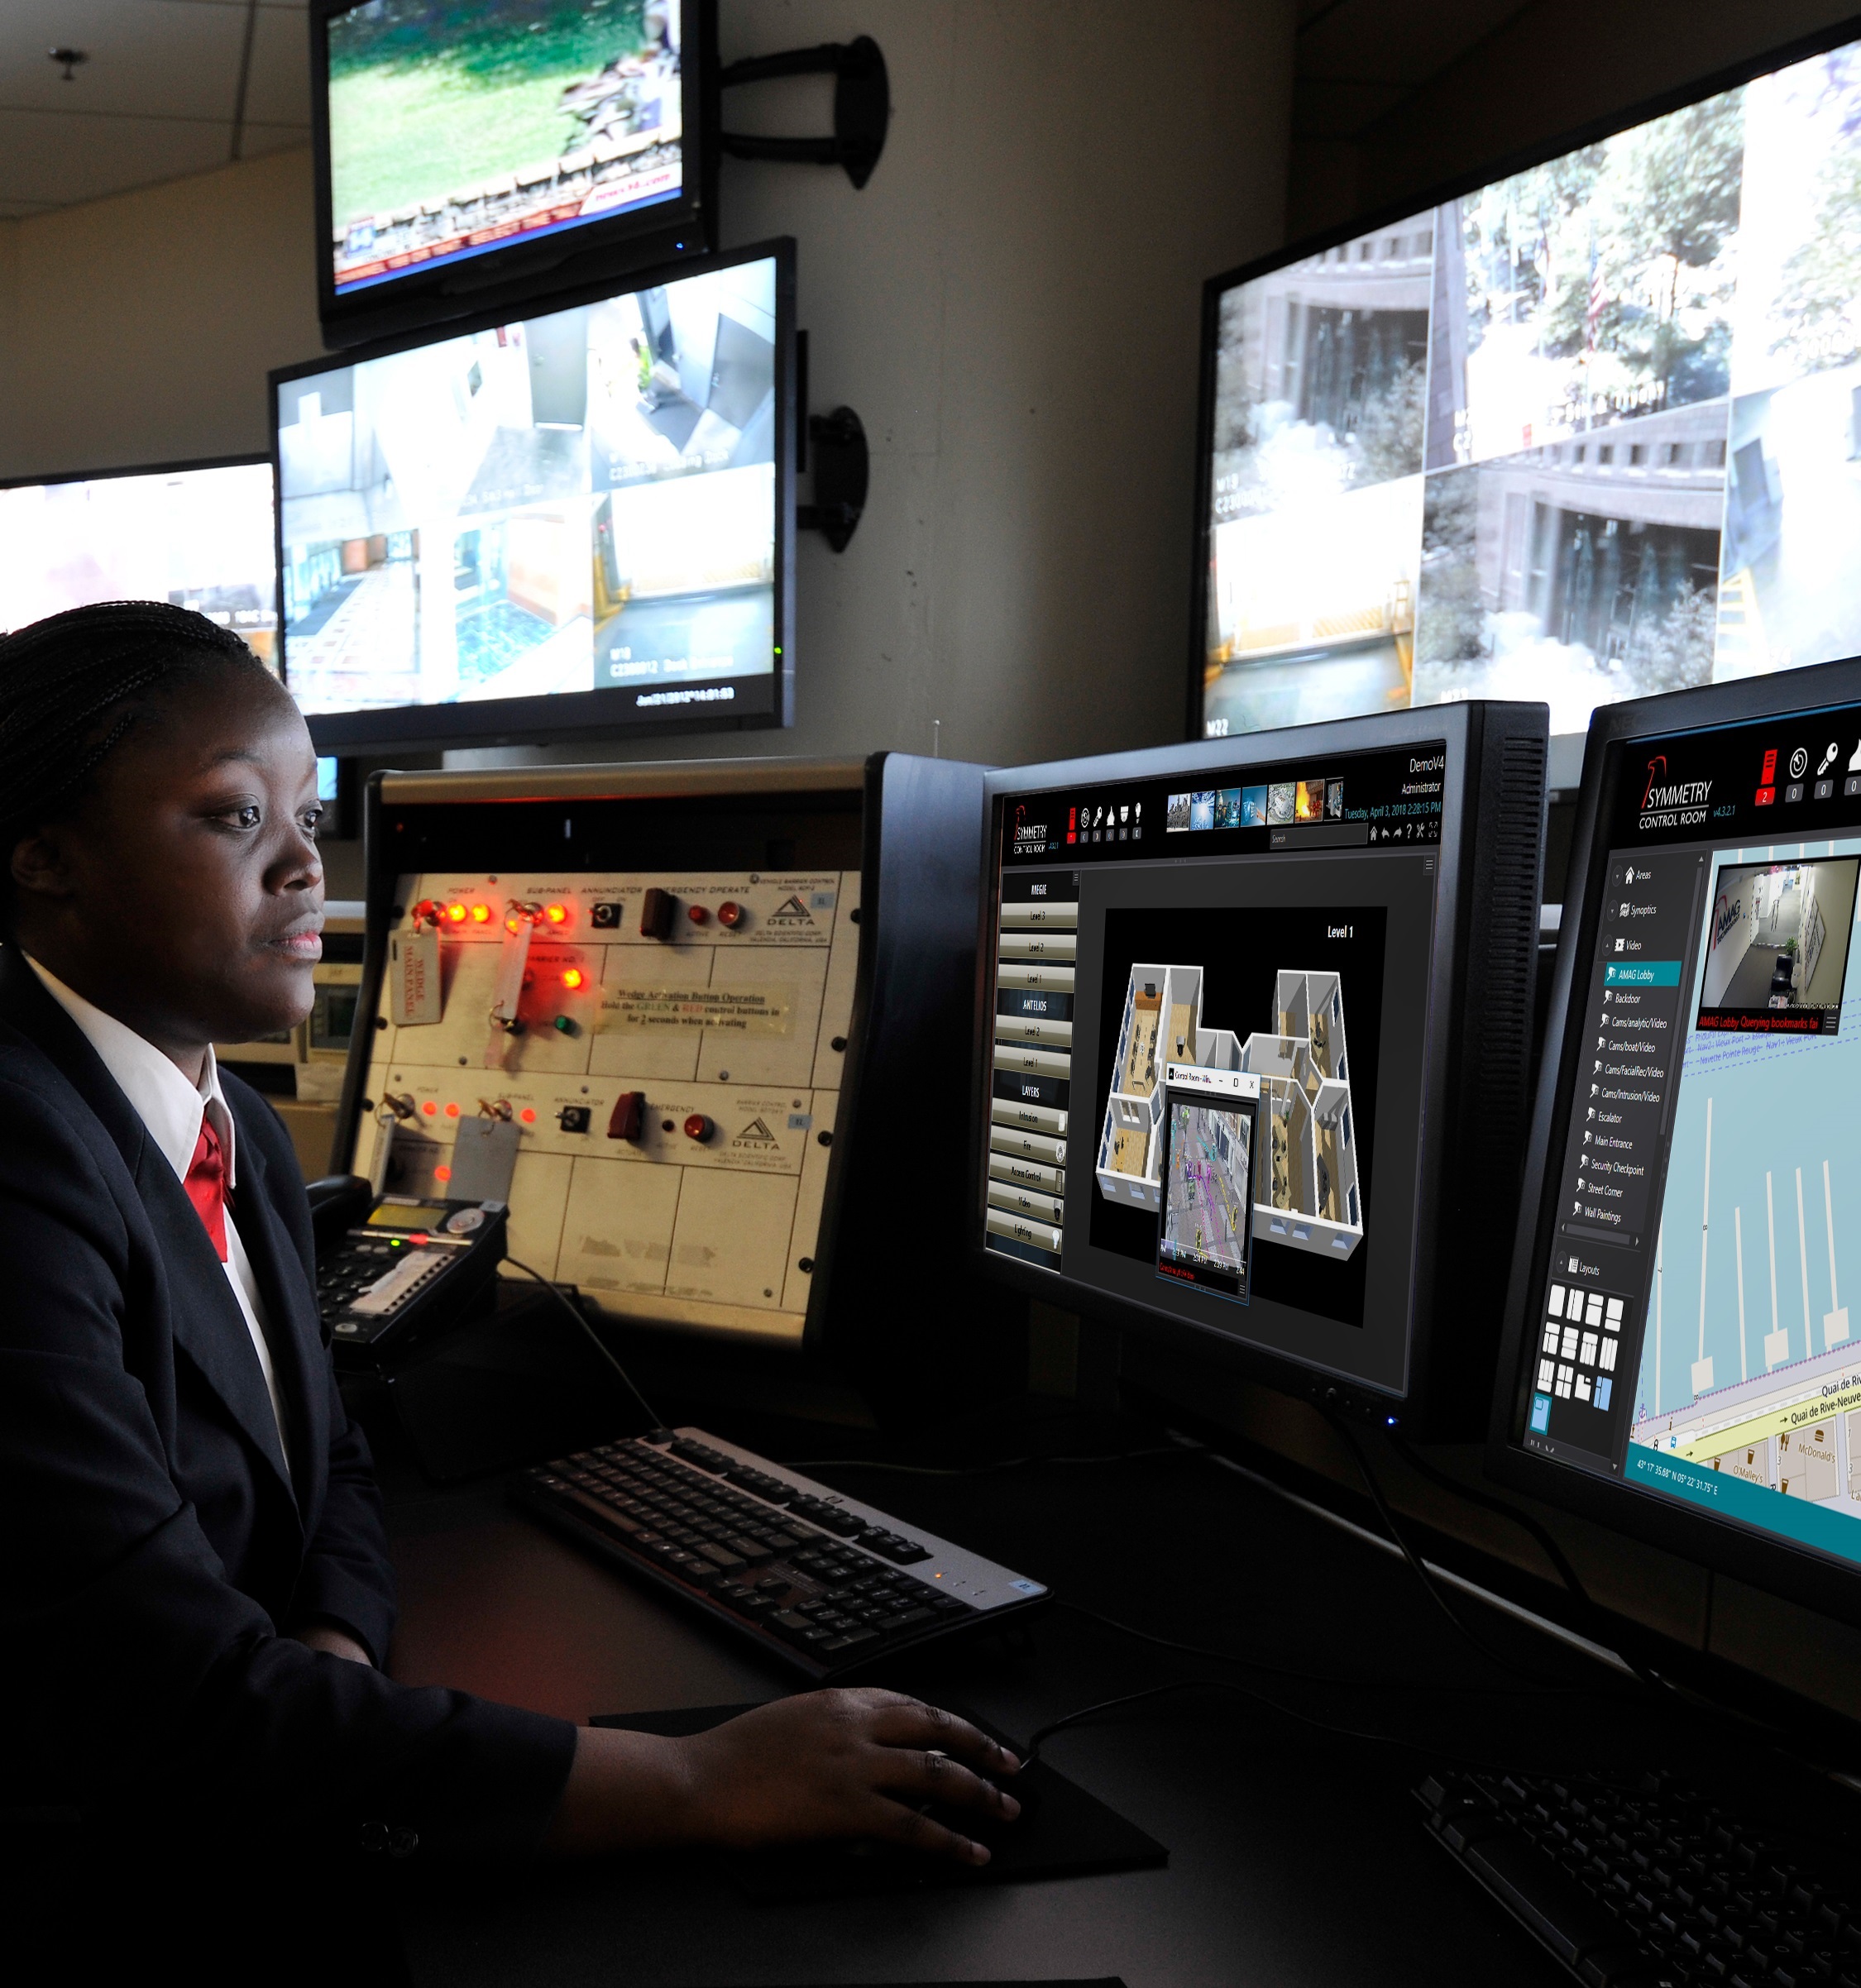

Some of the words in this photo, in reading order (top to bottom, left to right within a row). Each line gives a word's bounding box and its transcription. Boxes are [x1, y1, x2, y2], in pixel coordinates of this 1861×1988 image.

[1409, 755, 1445, 773] DemoV4
[1401, 782, 1442, 795] Administrator
[1820, 784, 1826, 796] 0
[1851, 780, 1857, 792] 0
[1647, 780, 1713, 809] SYMMETRY
[1762, 791, 1768, 803] 2
[1792, 787, 1797, 800] 0
[1370, 805, 1385, 820] April
[1391, 803, 1407, 816] 2018
[1430, 800, 1442, 813] PM
[1639, 813, 1678, 829] CONTROL
[1680, 810, 1707, 825] ROOM
[1635, 870, 1652, 880] Areas
[1630, 905, 1657, 916] Synoptics
[766, 918, 816, 926] DELTA
[1328, 925, 1347, 938] Level
[1349, 925, 1353, 938] 1
[1626, 939, 1642, 951] Video
[1619, 969, 1637, 980] AMAG
[1637, 969, 1655, 982] Lobby
[1615, 992, 1641, 1004] Backdoor
[672, 1003, 680, 1012] &
[737, 1006, 769, 1016] buttons
[771, 1007, 780, 1016] in
[627, 1013, 639, 1023] for
[648, 1015, 680, 1025] seconds
[682, 1016, 703, 1026] when
[1611, 1016, 1667, 1030] Cams/analytic/Video
[1698, 1016, 1720, 1028] AMAG
[1720, 1016, 1739, 1030] Lobby
[1740, 1016, 1770, 1031] Querying
[1771, 1016, 1808, 1030] bookmarks
[1608, 1039, 1656, 1053] Cams/boat/Video
[1605, 1063, 1664, 1078] Cams/FacialRec/Video
[1021, 1085, 1040, 1098] LAYERS
[1601, 1087, 1660, 1102] Cams/Intrusion/Video
[1598, 1111, 1623, 1123] Escalator
[732, 1140, 780, 1150] DELTA
[1594, 1135, 1609, 1147] Main
[1609, 1136, 1633, 1149] Entrance
[1591, 1159, 1613, 1174] Security
[1613, 1161, 1644, 1177] Checkpoint
[1587, 1183, 1604, 1195] Street
[1604, 1185, 1624, 1197] Corner
[1585, 1206, 1597, 1217] Wall
[1596, 1208, 1621, 1225] Paintings
[1579, 1261, 1600, 1276] Layouts
[1821, 1382, 1839, 1398] Quai
[1840, 1377, 1851, 1390] de
[1791, 1410, 1809, 1425] Quai
[1809, 1406, 1820, 1418] de
[1798, 1443, 1835, 1465] McDonald's
[1733, 1465, 1763, 1485] O'Malley's
[1848, 1463, 1854, 1474] 3
[1637, 1459, 1647, 1469] 43°
[1647, 1460, 1655, 1471] 17'
[1672, 1470, 1677, 1480] N
[1677, 1472, 1687, 1483] 05°
[1686, 1476, 1696, 1487] 22'
[1714, 1485, 1719, 1496] E
